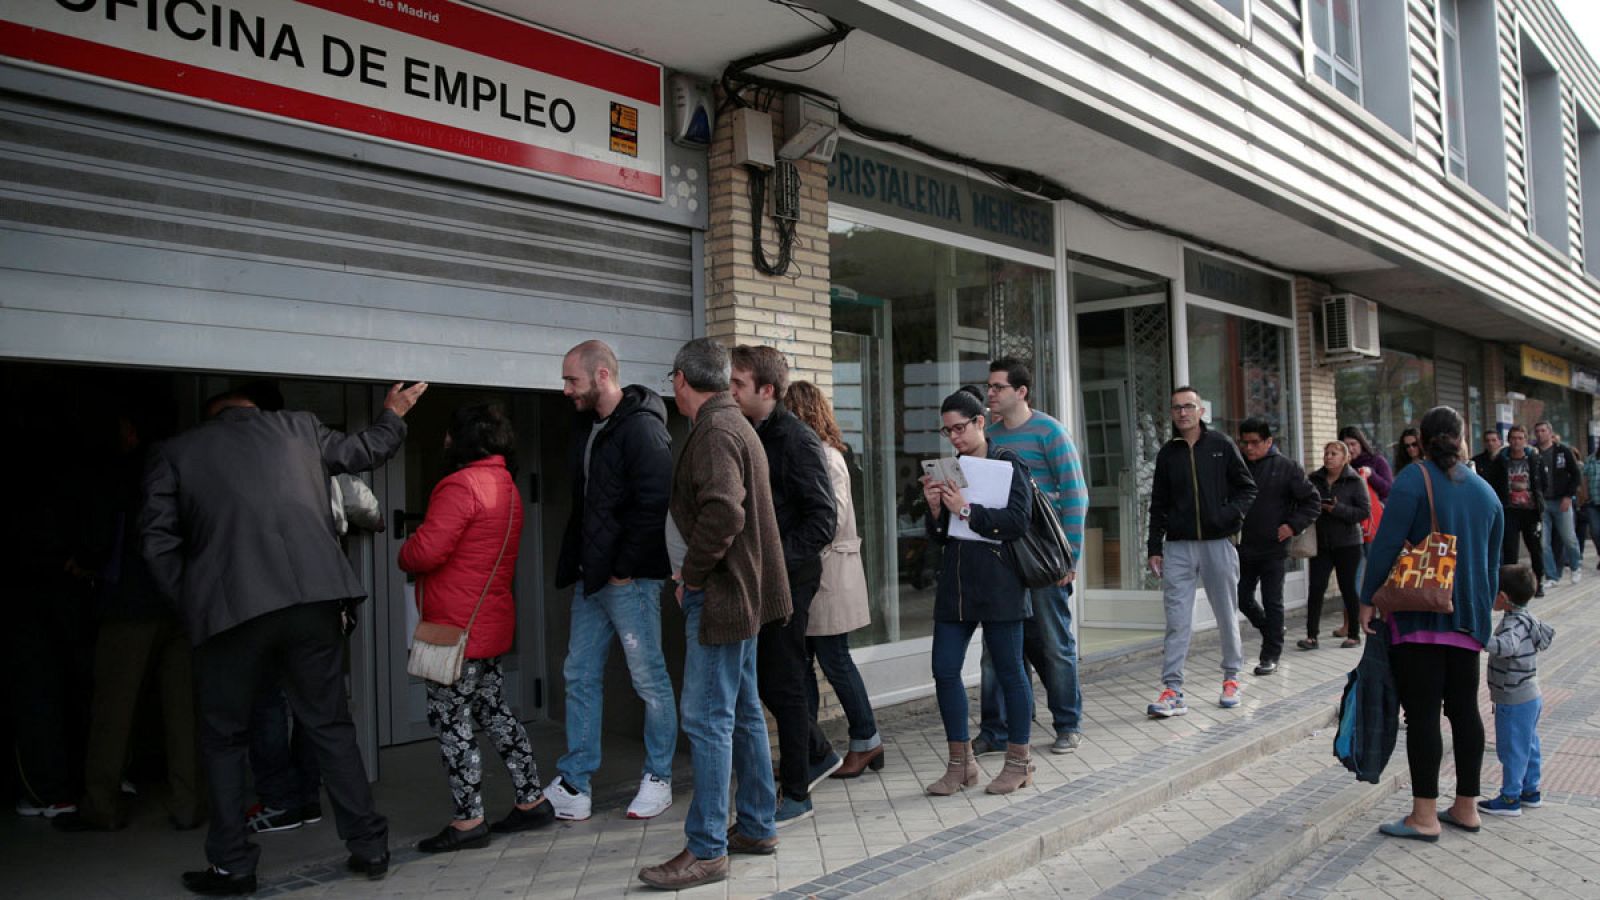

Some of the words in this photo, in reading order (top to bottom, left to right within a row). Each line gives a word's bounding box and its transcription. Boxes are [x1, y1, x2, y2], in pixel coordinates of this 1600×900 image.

[397, 2, 440, 23] Madrid
[54, 0, 306, 68] ICINA
[322, 34, 388, 89] DE
[404, 56, 576, 133] EMPLEO
[828, 151, 962, 223] CRISTALERIA
[972, 191, 1050, 246] MENESES
